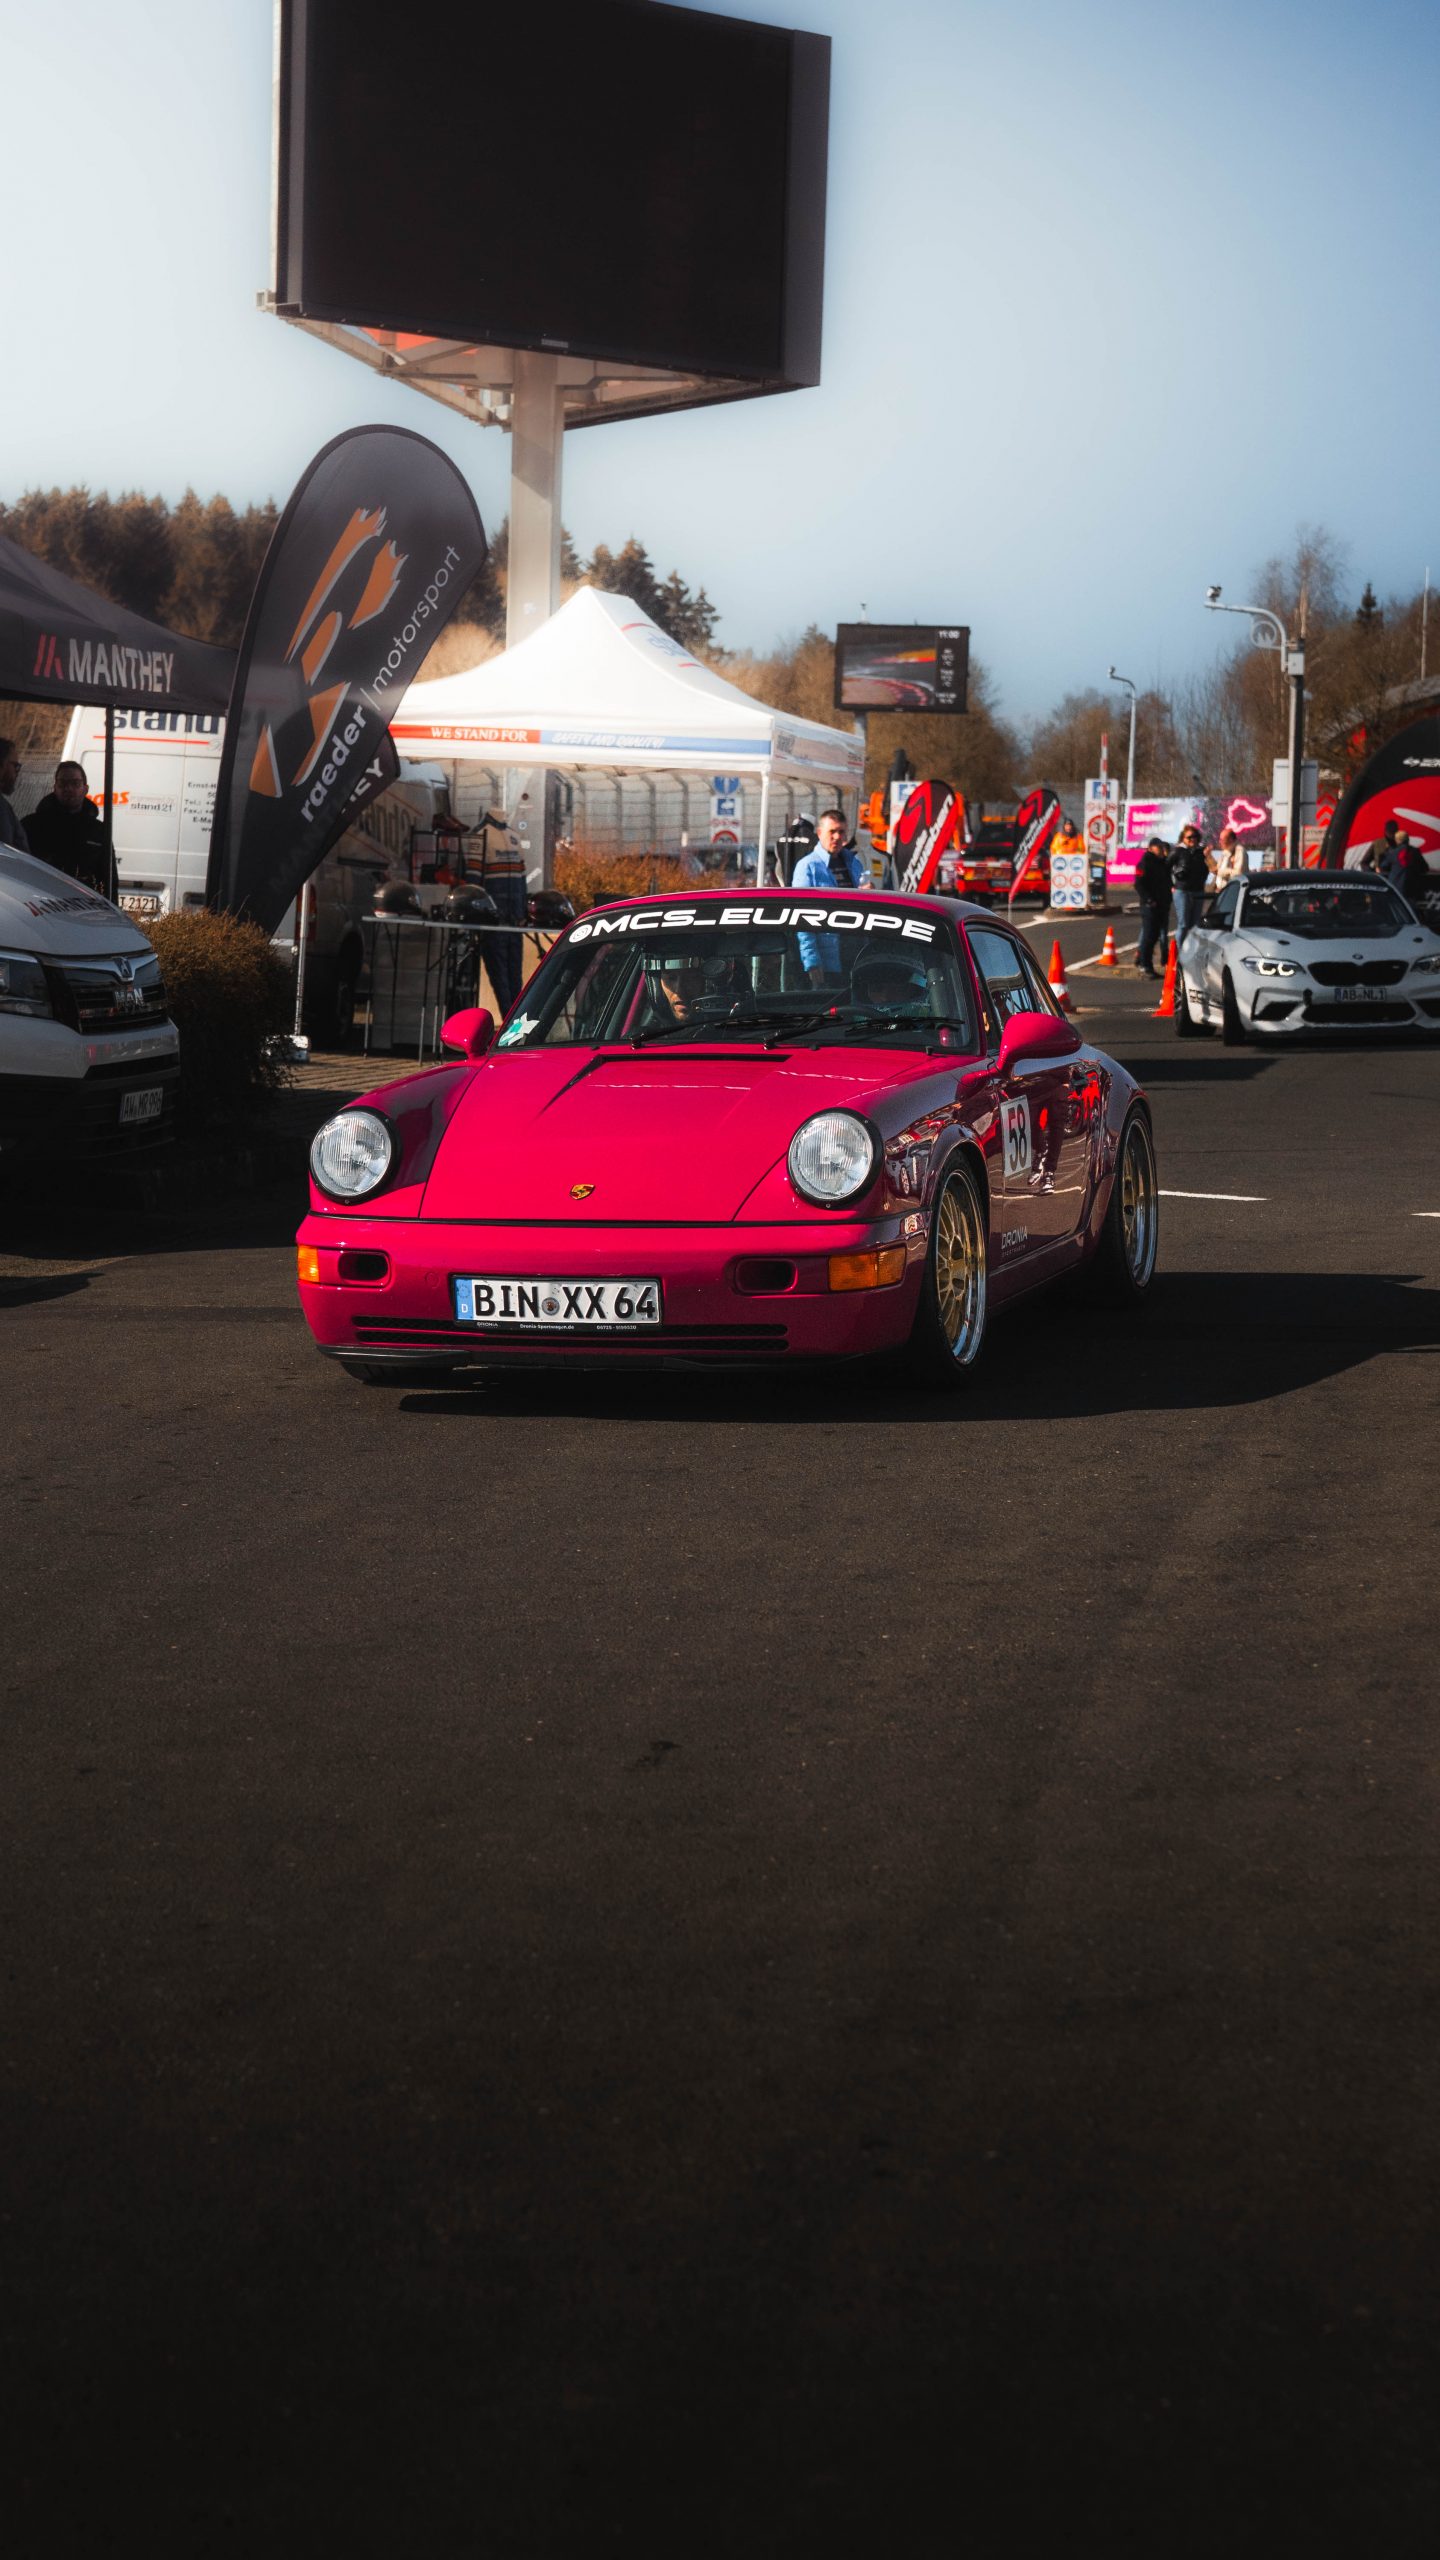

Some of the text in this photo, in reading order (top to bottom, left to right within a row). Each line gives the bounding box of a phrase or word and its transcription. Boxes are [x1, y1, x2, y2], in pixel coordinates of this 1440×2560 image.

[69, 638, 174, 693] MANTHEY
[301, 545, 461, 823] raeder motorsport
[431, 727, 527, 743] WE STAND FOR
[1007, 1103, 1028, 1171] 58
[1002, 1226, 1028, 1250] DRONIA
[474, 1284, 540, 1318] BIN
[562, 1286, 607, 1319] XX
[614, 1287, 656, 1319] 64
